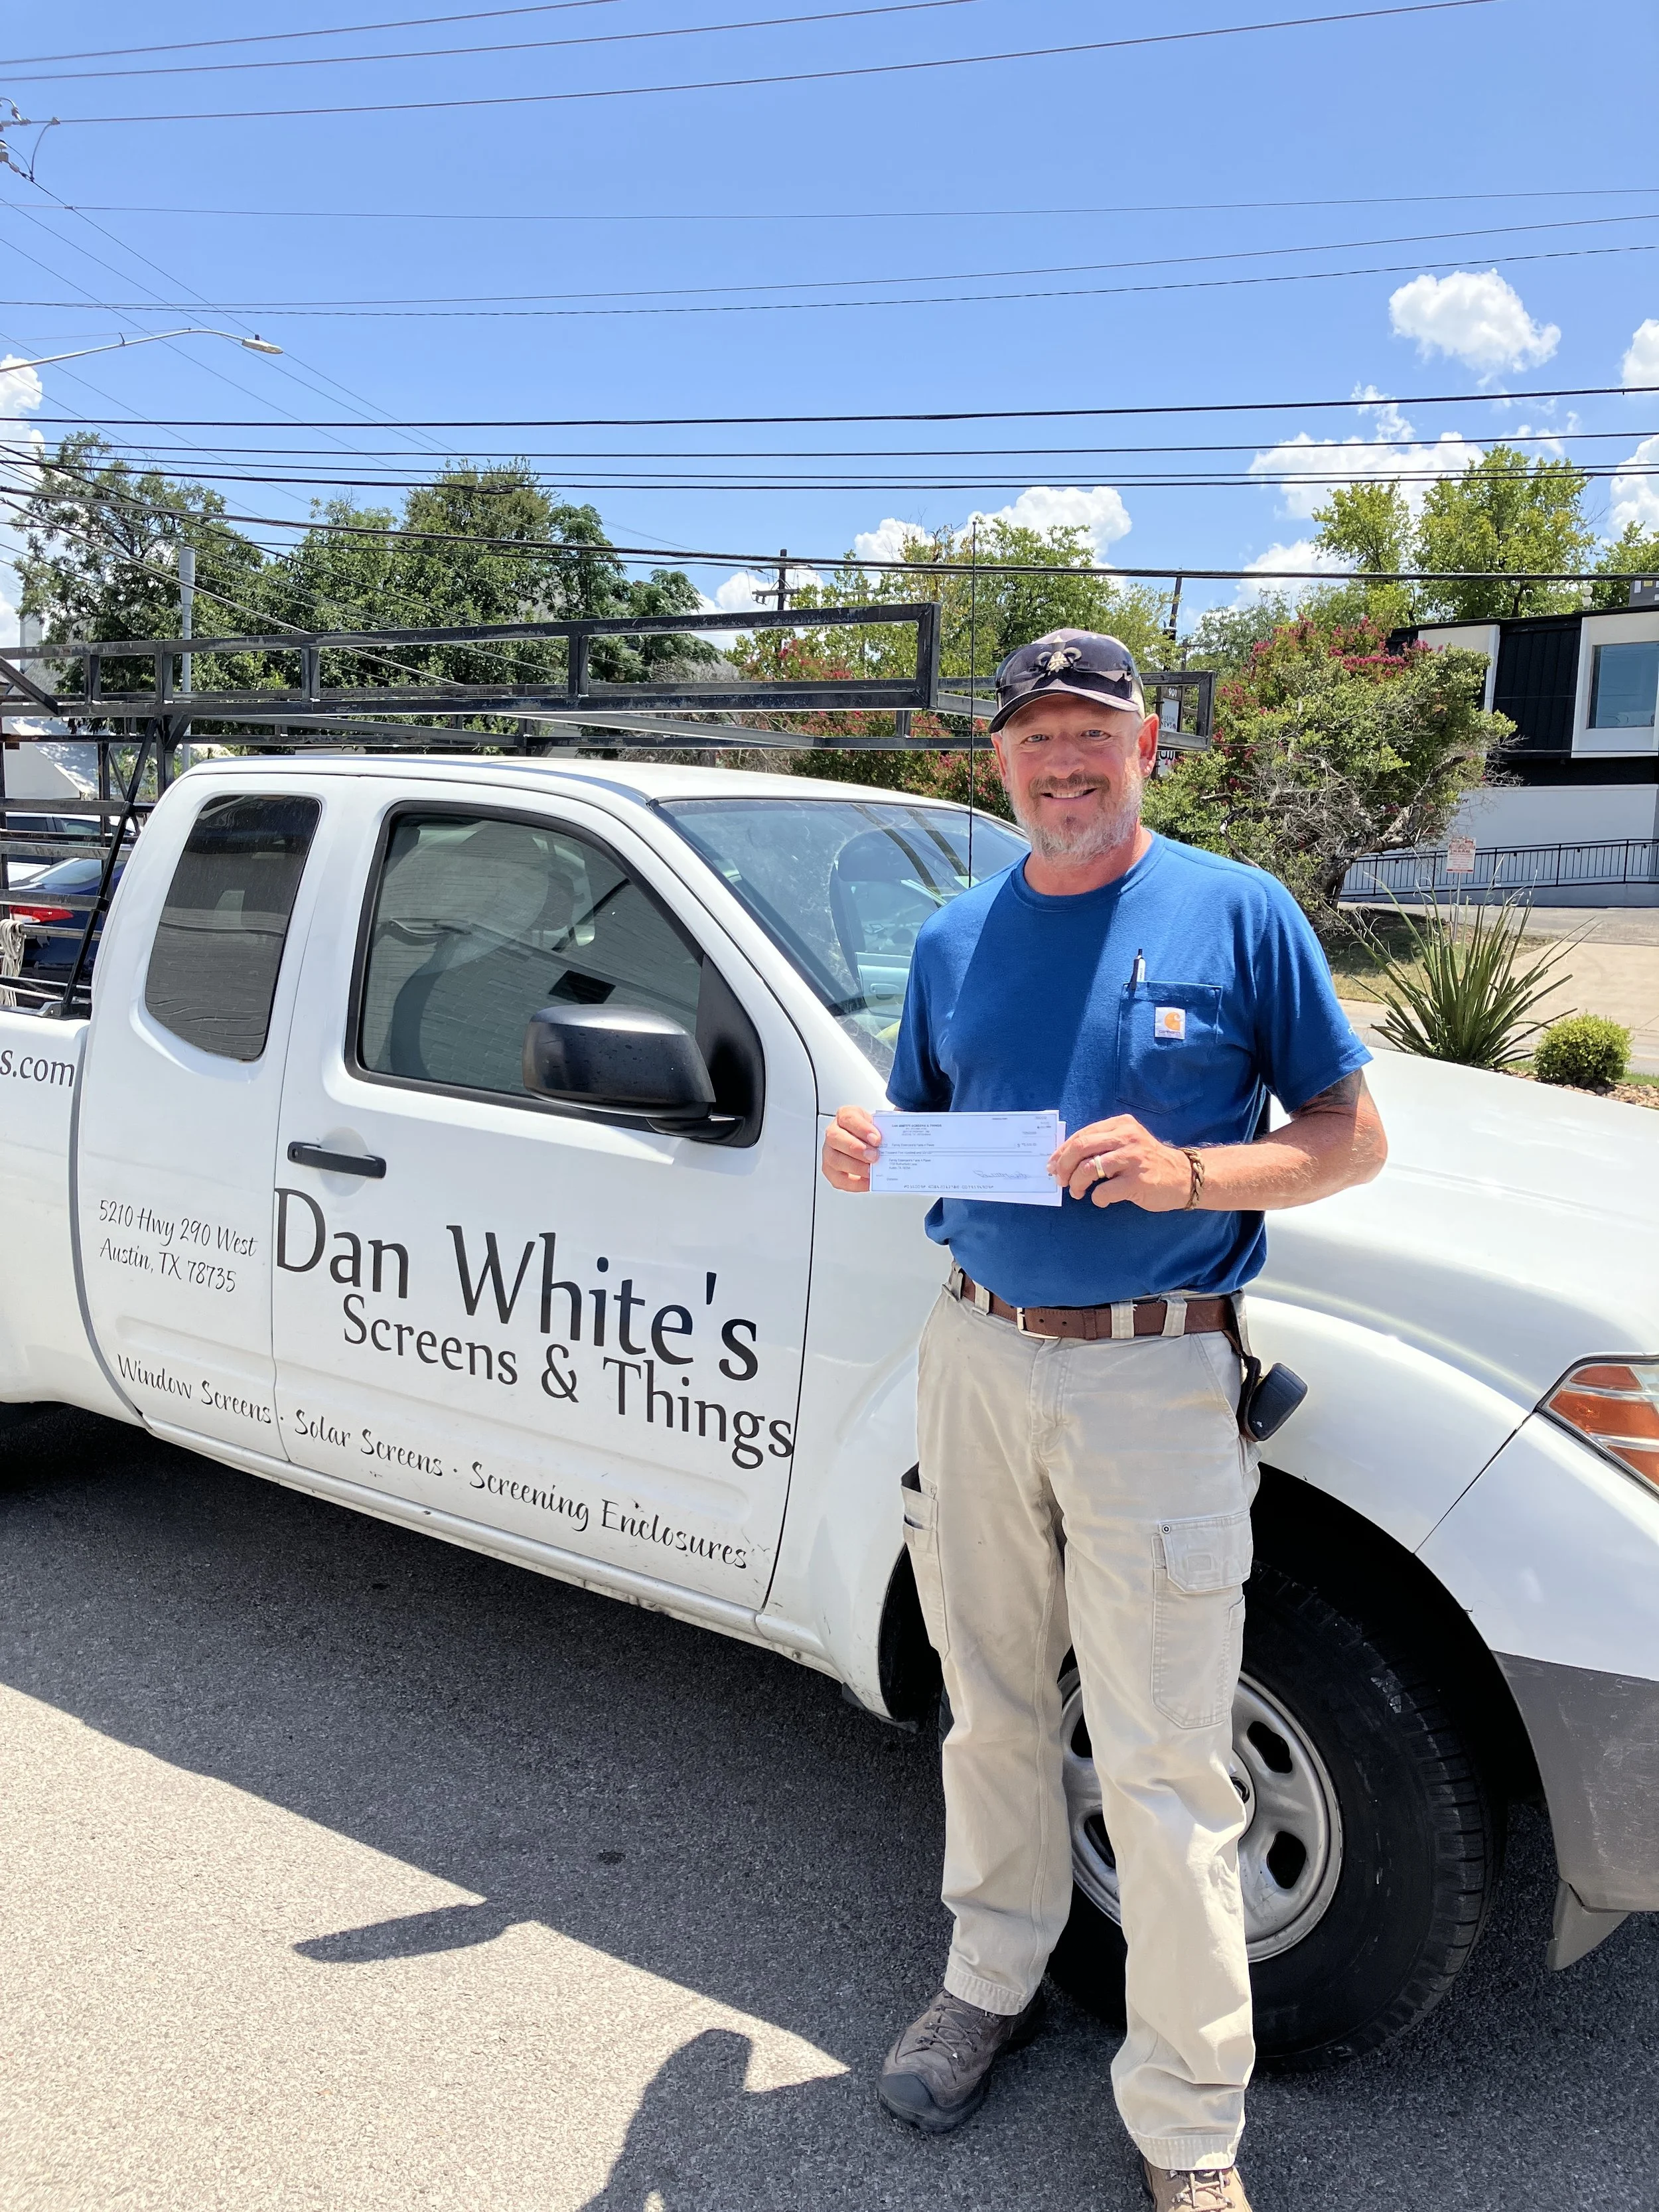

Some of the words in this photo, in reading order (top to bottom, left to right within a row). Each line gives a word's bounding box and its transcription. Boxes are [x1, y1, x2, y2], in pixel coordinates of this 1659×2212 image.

[1168, 688, 1177, 697] 901
[99, 1199, 133, 1227] 5210
[137, 1207, 175, 1246] Hwy
[179, 1218, 211, 1246] 290
[217, 1225, 258, 1257] West
[100, 1238, 153, 1274] Austin,
[158, 1252, 182, 1280] TX
[187, 1260, 237, 1293] 78735
[275, 1187, 409, 1299] Dan
[446, 1224, 758, 1381] White's
[343, 1293, 518, 1385] Screens
[541, 1343, 579, 1404] &
[603, 1356, 792, 1470] Things
[117, 1353, 192, 1400] Window
[200, 1380, 272, 1424] Screens
[294, 1409, 351, 1447] Solar
[360, 1428, 443, 1477] Screens
[469, 1461, 589, 1532] Screening
[601, 1499, 747, 1570] Enclosures
